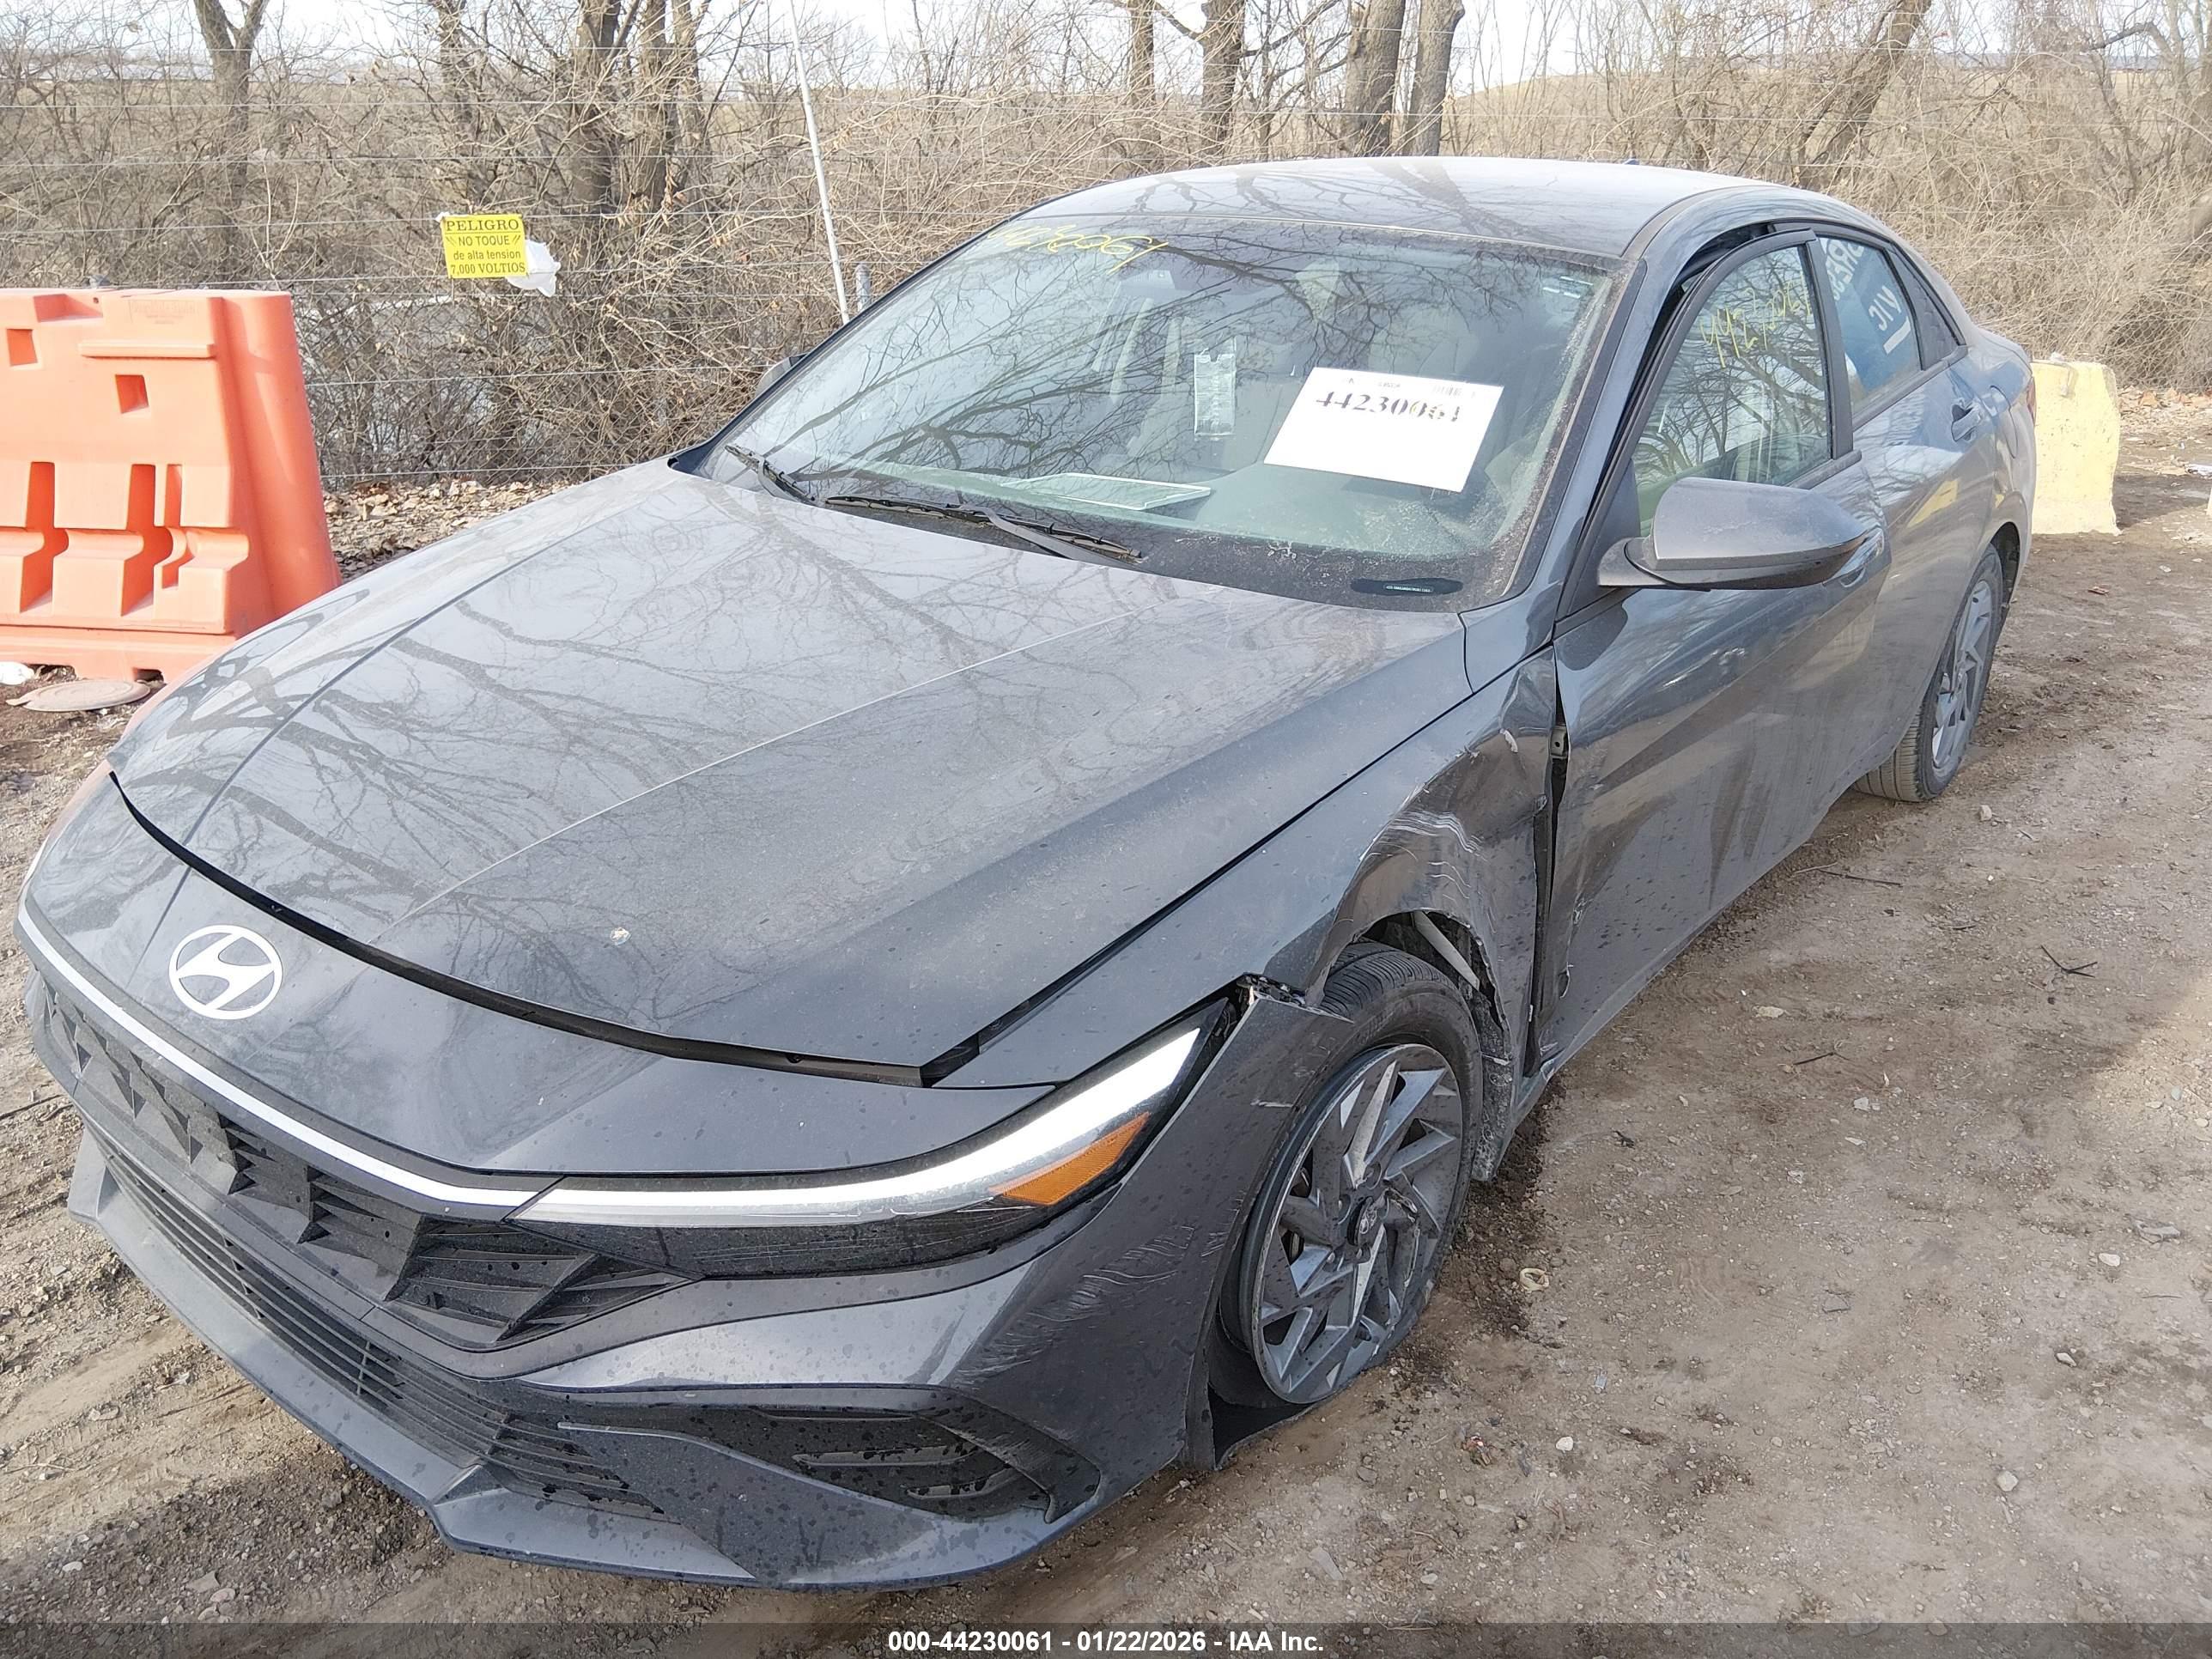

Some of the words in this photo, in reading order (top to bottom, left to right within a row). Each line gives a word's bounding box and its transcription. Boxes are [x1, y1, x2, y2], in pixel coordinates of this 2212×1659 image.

[446, 219, 520, 232] PELIGRO
[458, 235, 473, 246] NO
[475, 234, 510, 246] TOQUE
[453, 250, 465, 261] de
[467, 249, 484, 260] alta
[487, 249, 521, 260] tension
[450, 264, 476, 276] 7,000
[477, 262, 526, 274] VOLTIOS
